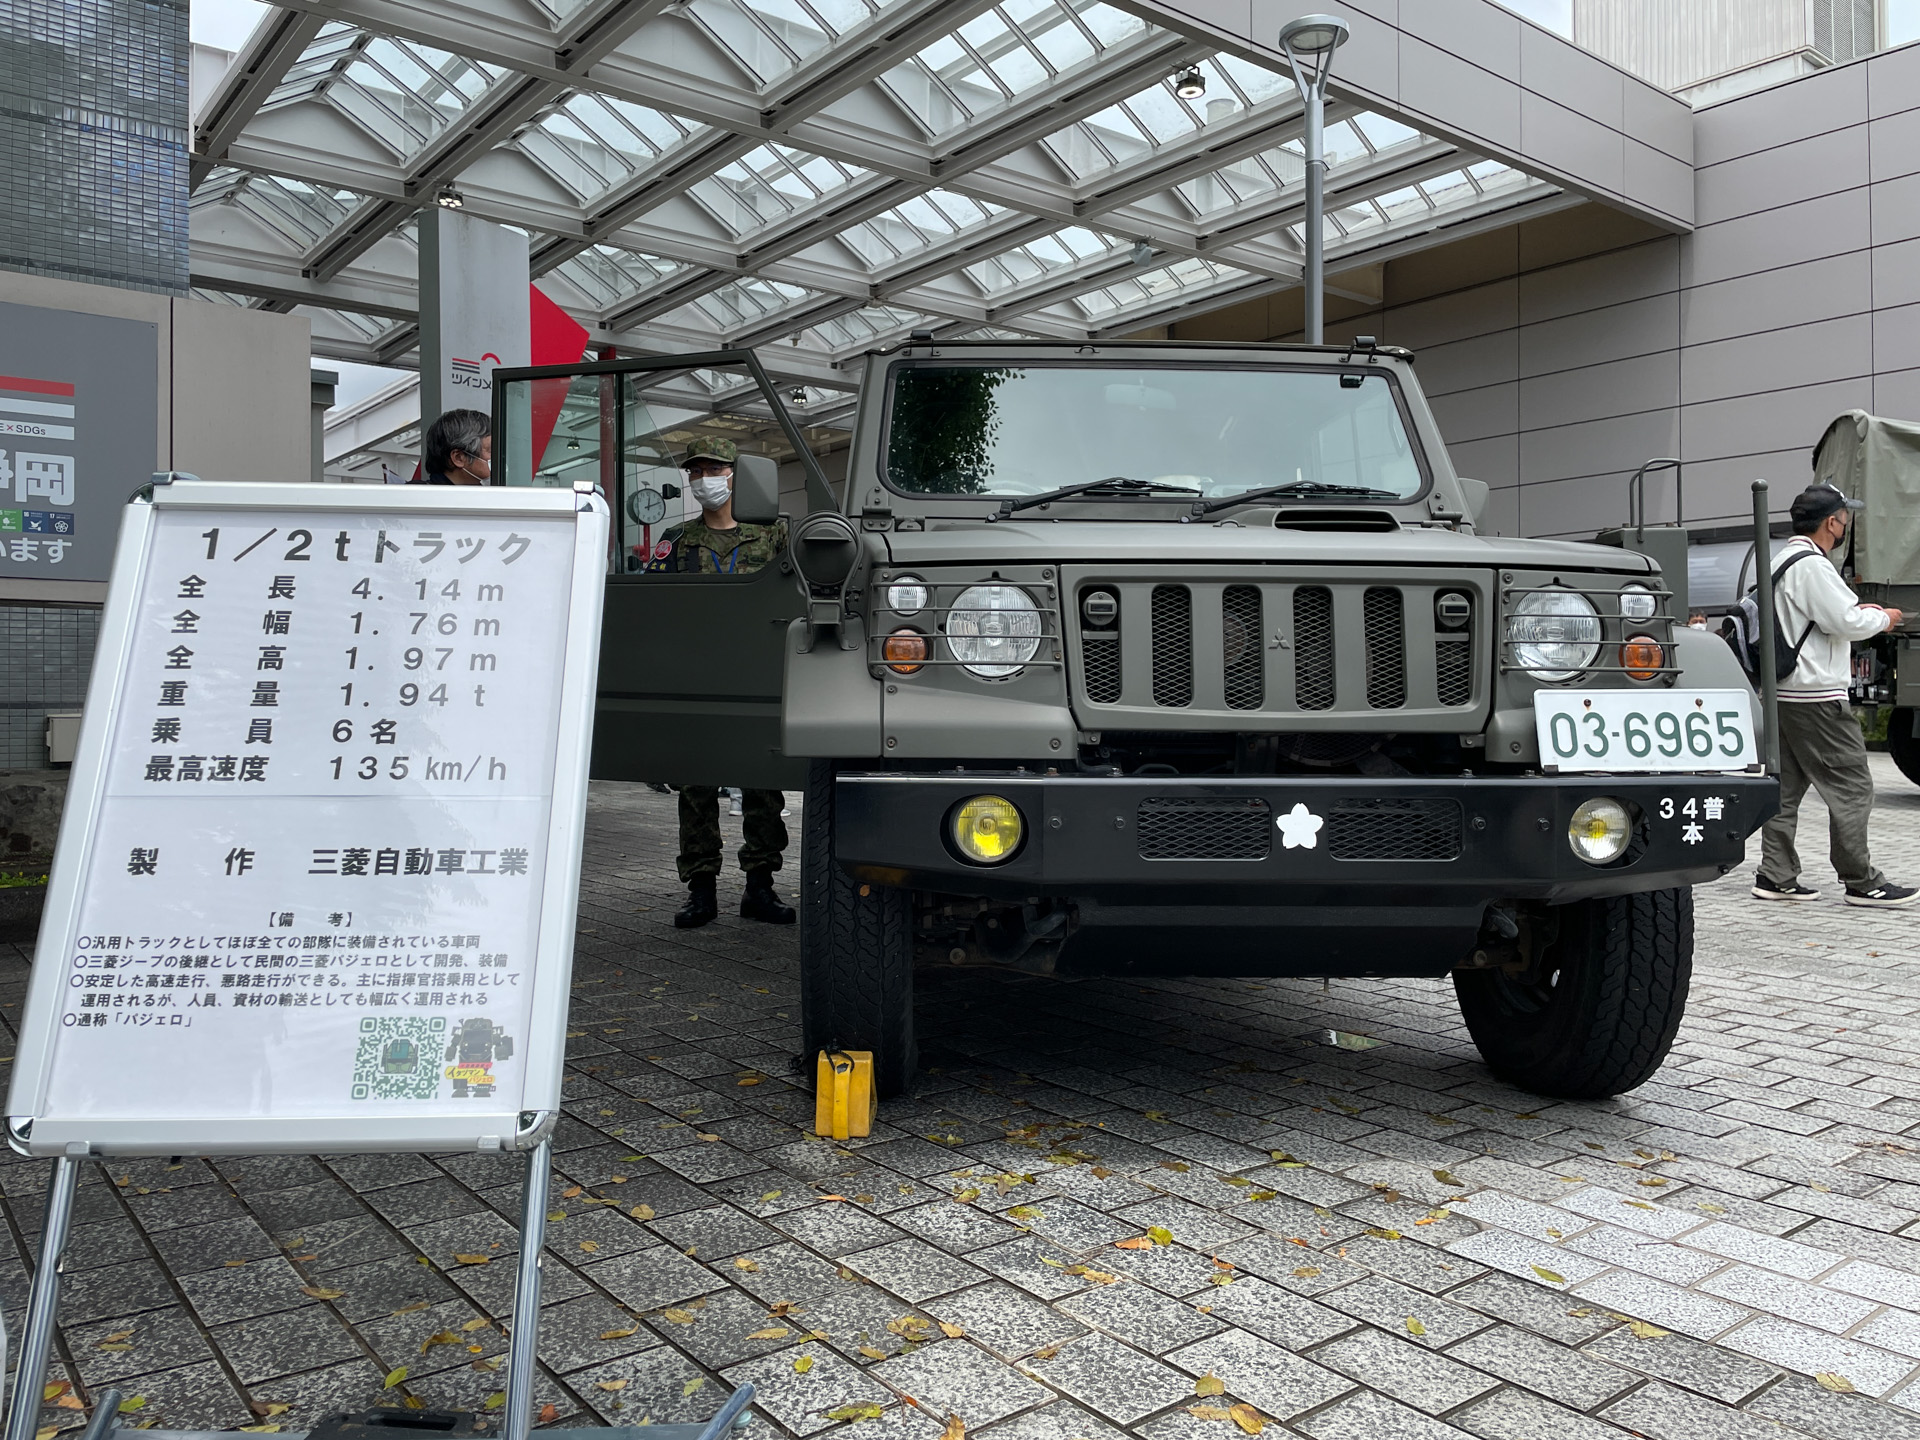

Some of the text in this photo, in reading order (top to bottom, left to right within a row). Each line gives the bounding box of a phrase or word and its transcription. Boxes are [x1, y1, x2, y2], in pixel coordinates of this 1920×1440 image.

[0, 449, 75, 506] 岡
[1549, 711, 1744, 758] 03-6965
[144, 755, 506, 782] 最高速度 135km/h
[1681, 821, 1704, 845] 本
[308, 848, 528, 876] 三菱自動車工業
